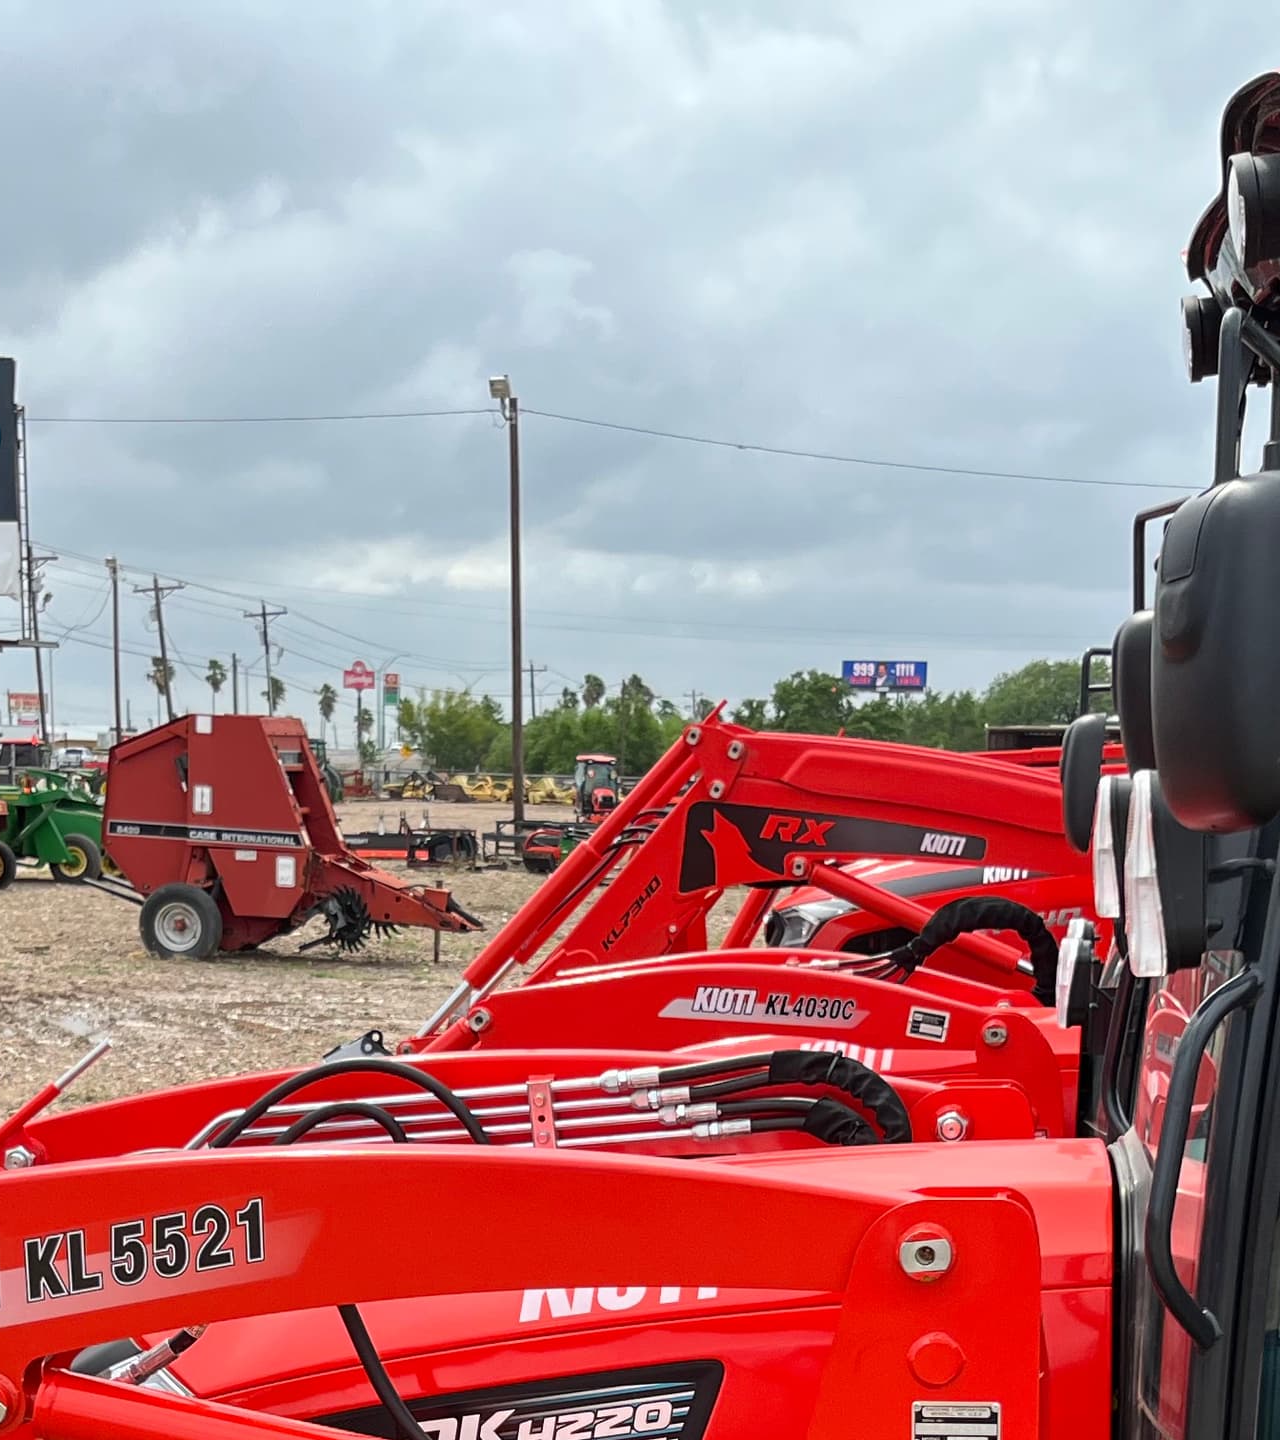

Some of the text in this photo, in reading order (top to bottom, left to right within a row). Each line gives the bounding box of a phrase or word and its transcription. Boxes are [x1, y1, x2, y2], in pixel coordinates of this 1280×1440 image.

[853, 663, 875, 676] 999
[189, 831, 217, 840] CASE
[221, 833, 297, 846] INTERNATIONAL
[760, 814, 836, 846] RX
[920, 832, 966, 857] KIOTI
[600, 873, 662, 952] KL7340
[691, 985, 856, 1020] KIOTI KL4030C
